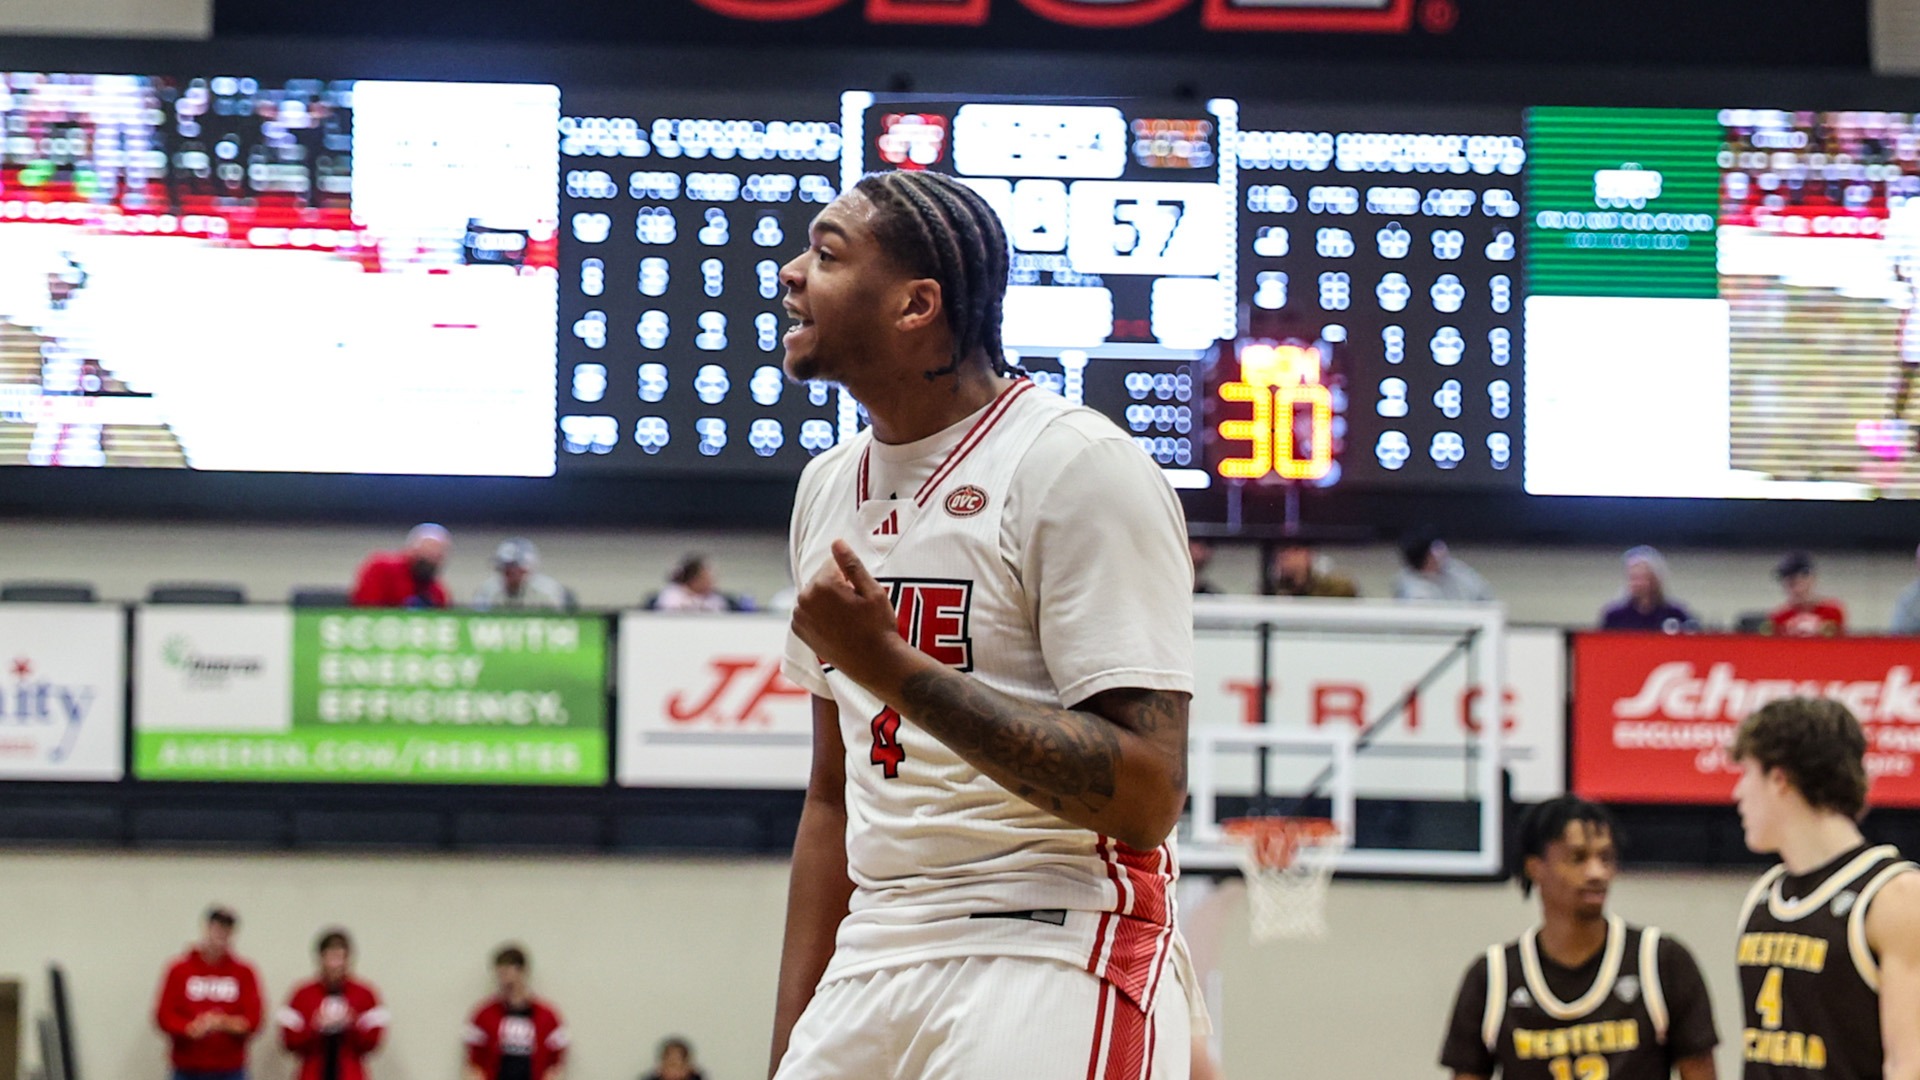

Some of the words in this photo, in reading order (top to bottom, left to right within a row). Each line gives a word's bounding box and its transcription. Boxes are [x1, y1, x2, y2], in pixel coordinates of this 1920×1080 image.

[1113, 199, 1185, 258] 57
[1218, 381, 1332, 479] 30
[950, 494, 979, 511] OVC
[319, 615, 459, 650] SCORE
[467, 617, 579, 653] WITH
[319, 651, 484, 687] ENERGY
[0, 656, 96, 764] ity
[318, 688, 569, 725] EFFICIENCY.
[870, 705, 906, 779] 4
[1755, 966, 1784, 1030] 4
[1512, 1018, 1640, 1060] WESTERN
